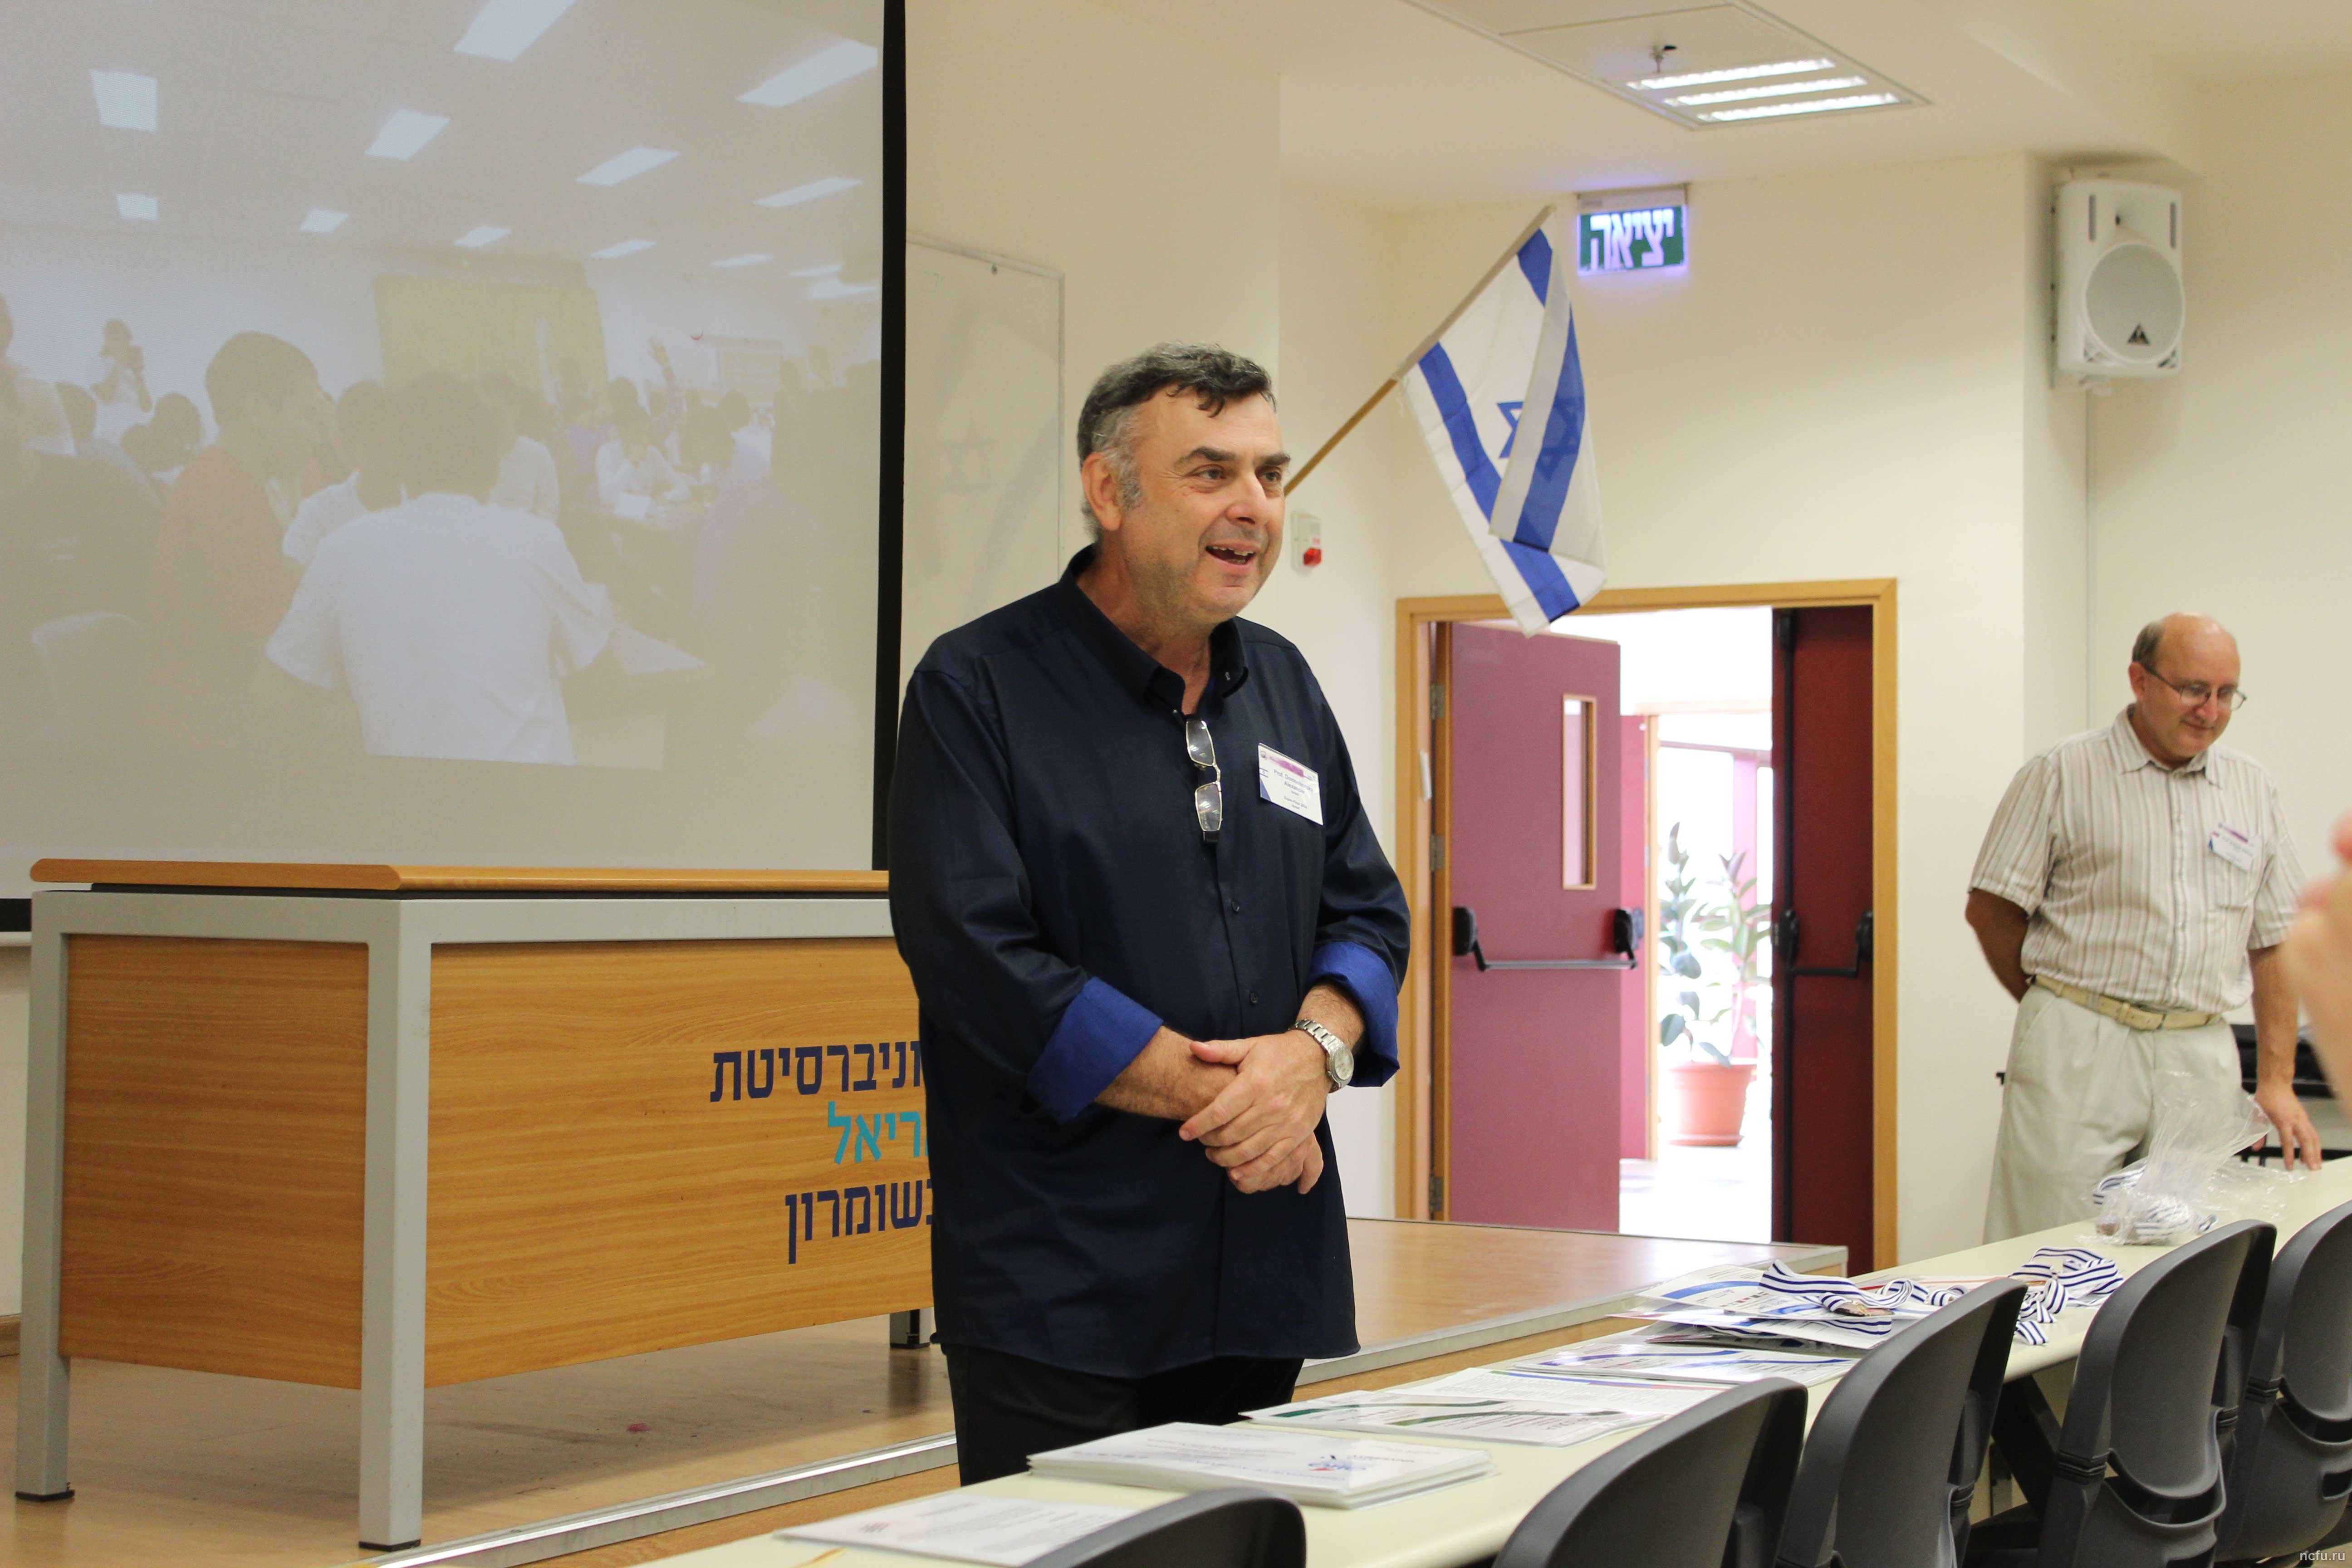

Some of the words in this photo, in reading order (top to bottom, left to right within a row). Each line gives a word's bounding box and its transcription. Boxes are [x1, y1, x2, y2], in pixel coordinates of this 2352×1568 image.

[1589, 207, 1675, 270] יציאה
[710, 1040, 921, 1102] וניברסיטת
[828, 1101, 929, 1165] ריאל
